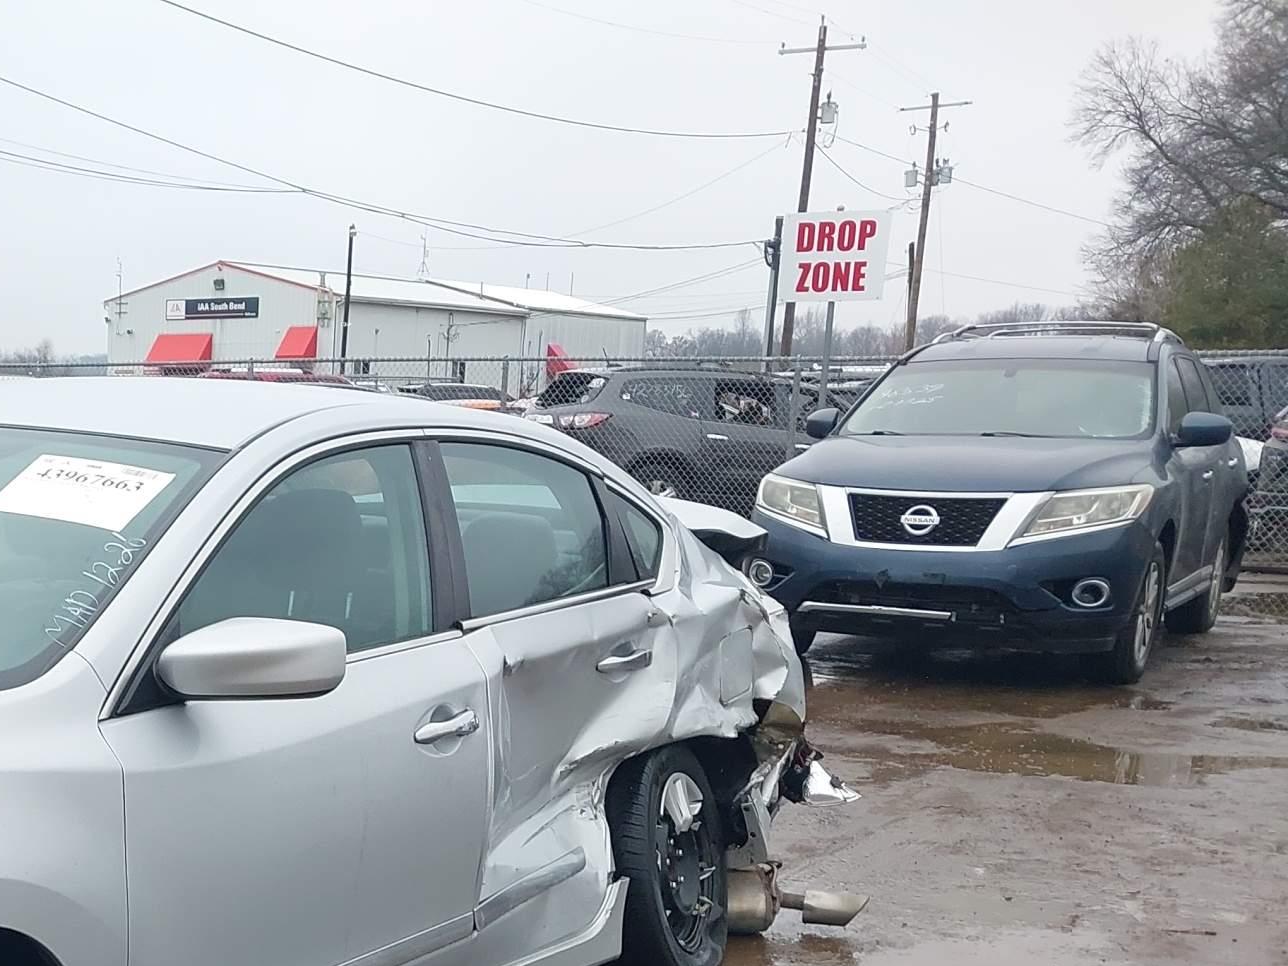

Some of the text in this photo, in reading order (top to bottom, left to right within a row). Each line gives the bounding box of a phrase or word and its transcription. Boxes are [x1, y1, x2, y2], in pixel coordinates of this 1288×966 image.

[796, 219, 877, 252] DROP
[795, 261, 867, 293] ZONE
[197, 301, 246, 312] IAA South Bend
[36, 467, 145, 492] 43967663
[904, 516, 935, 524] NISSAN
